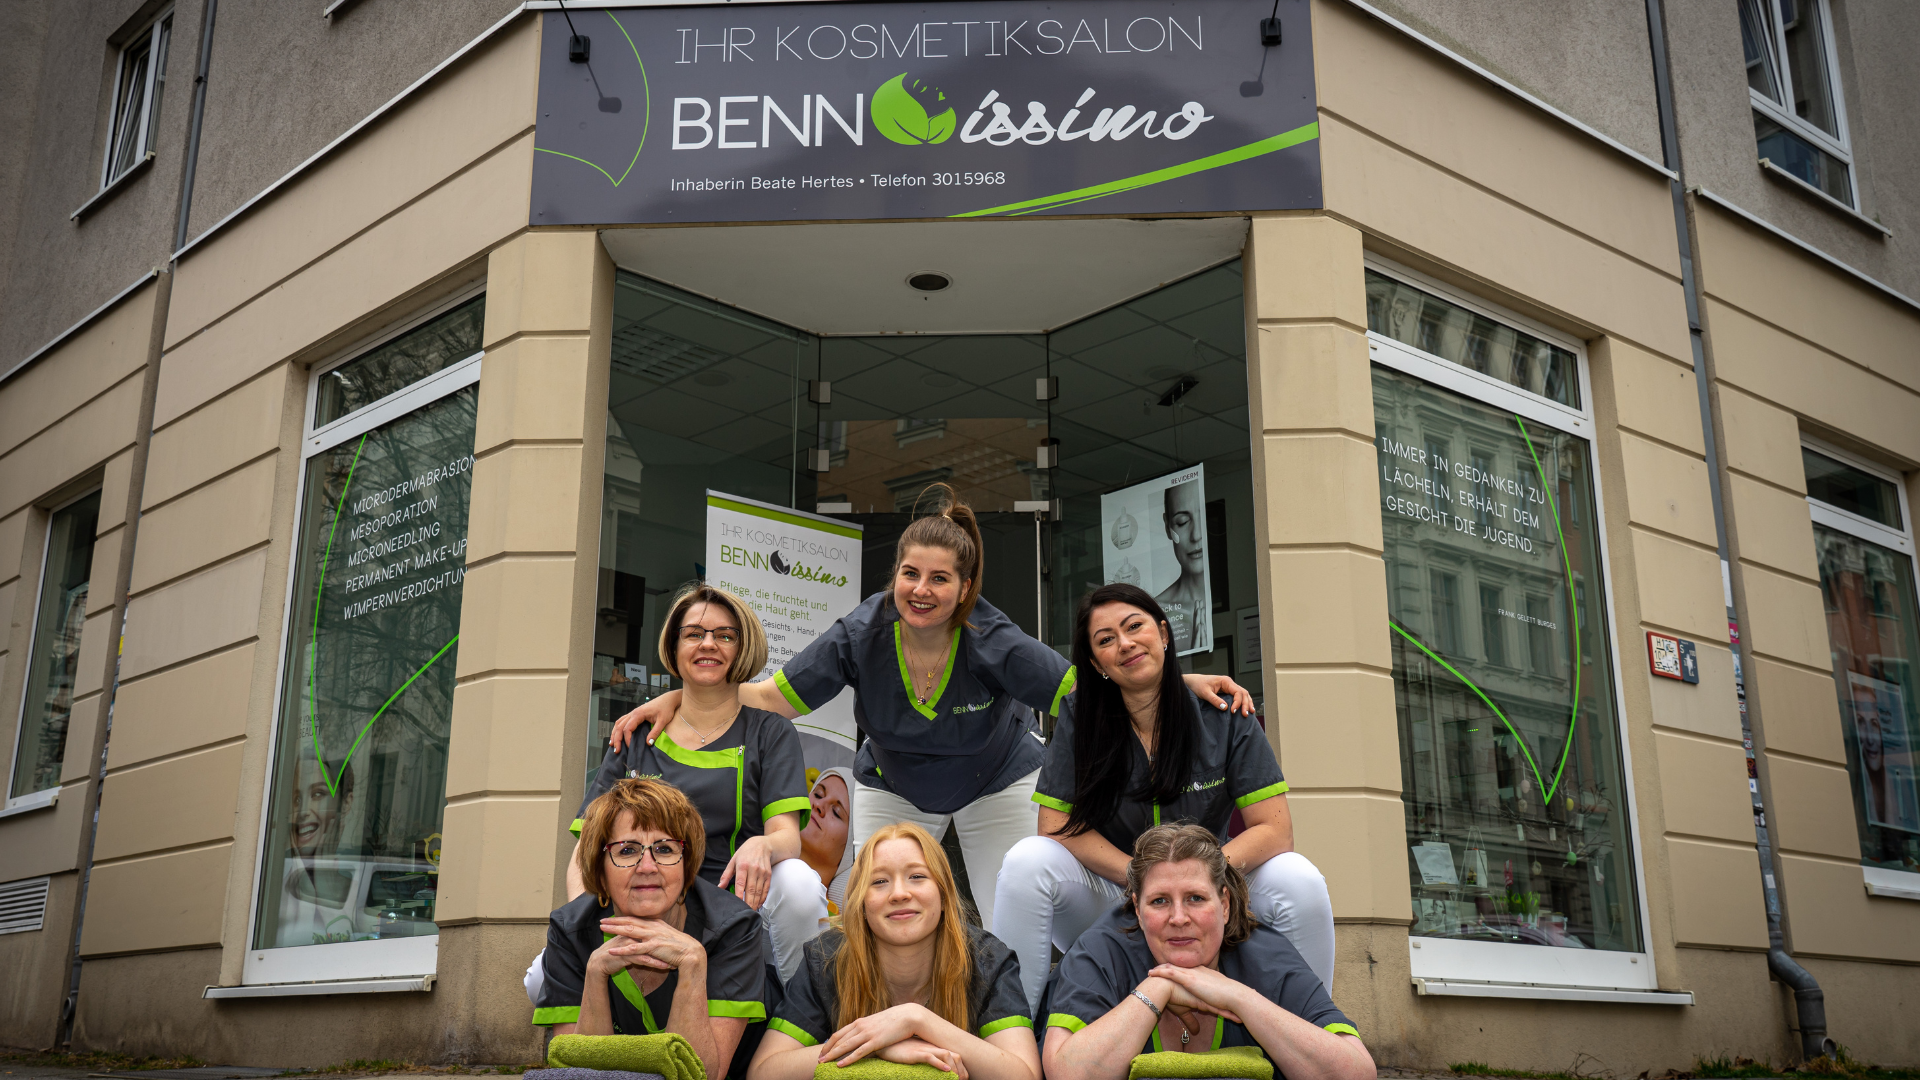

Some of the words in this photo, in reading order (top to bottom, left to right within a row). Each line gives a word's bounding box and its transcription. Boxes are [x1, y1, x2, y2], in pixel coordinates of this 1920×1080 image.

[674, 27, 755, 64] IHR
[775, 15, 1202, 61] KOSMETIKSALON
[671, 177, 745, 191] Inhaberin
[751, 176, 796, 190] Beate
[801, 174, 854, 189] Hertes
[870, 174, 926, 188] Telefon
[932, 171, 1006, 187] 3015968
[353, 454, 477, 516] MICRODERMABRASION
[1381, 436, 1427, 466] IMMER
[1433, 454, 1449, 473] IN
[1454, 462, 1524, 498] GEDANKEN
[1528, 486, 1545, 504] ZU
[350, 496, 438, 542] MESOPORATION
[1383, 465, 1454, 503] LÄCHELN,
[1459, 490, 1507, 519] ERHÄLT
[1513, 507, 1539, 530] DEM
[348, 521, 441, 568] MICRONEEDLING
[721, 522, 743, 539] IHR
[746, 530, 848, 563] KOSMETIKSALON
[1386, 496, 1448, 527] GESICHT
[1454, 516, 1477, 537] DIE
[1482, 525, 1536, 554] JUGEND.
[345, 558, 411, 594] PERMANENT
[414, 538, 468, 570] MAKE-UP
[343, 566, 468, 620] WIMPERNVERDICHTUN
[720, 580, 752, 598] Pflege,
[755, 588, 770, 600] die
[772, 591, 808, 608] fruchtet
[811, 602, 828, 612] und
[748, 600, 763, 611] die
[765, 602, 788, 616] Haut
[790, 609, 812, 621] geht.
[1174, 603, 1182, 611] to
[1498, 608, 1516, 619] FRANK
[1516, 613, 1536, 624] GELETT
[766, 632, 786, 642] ungen
